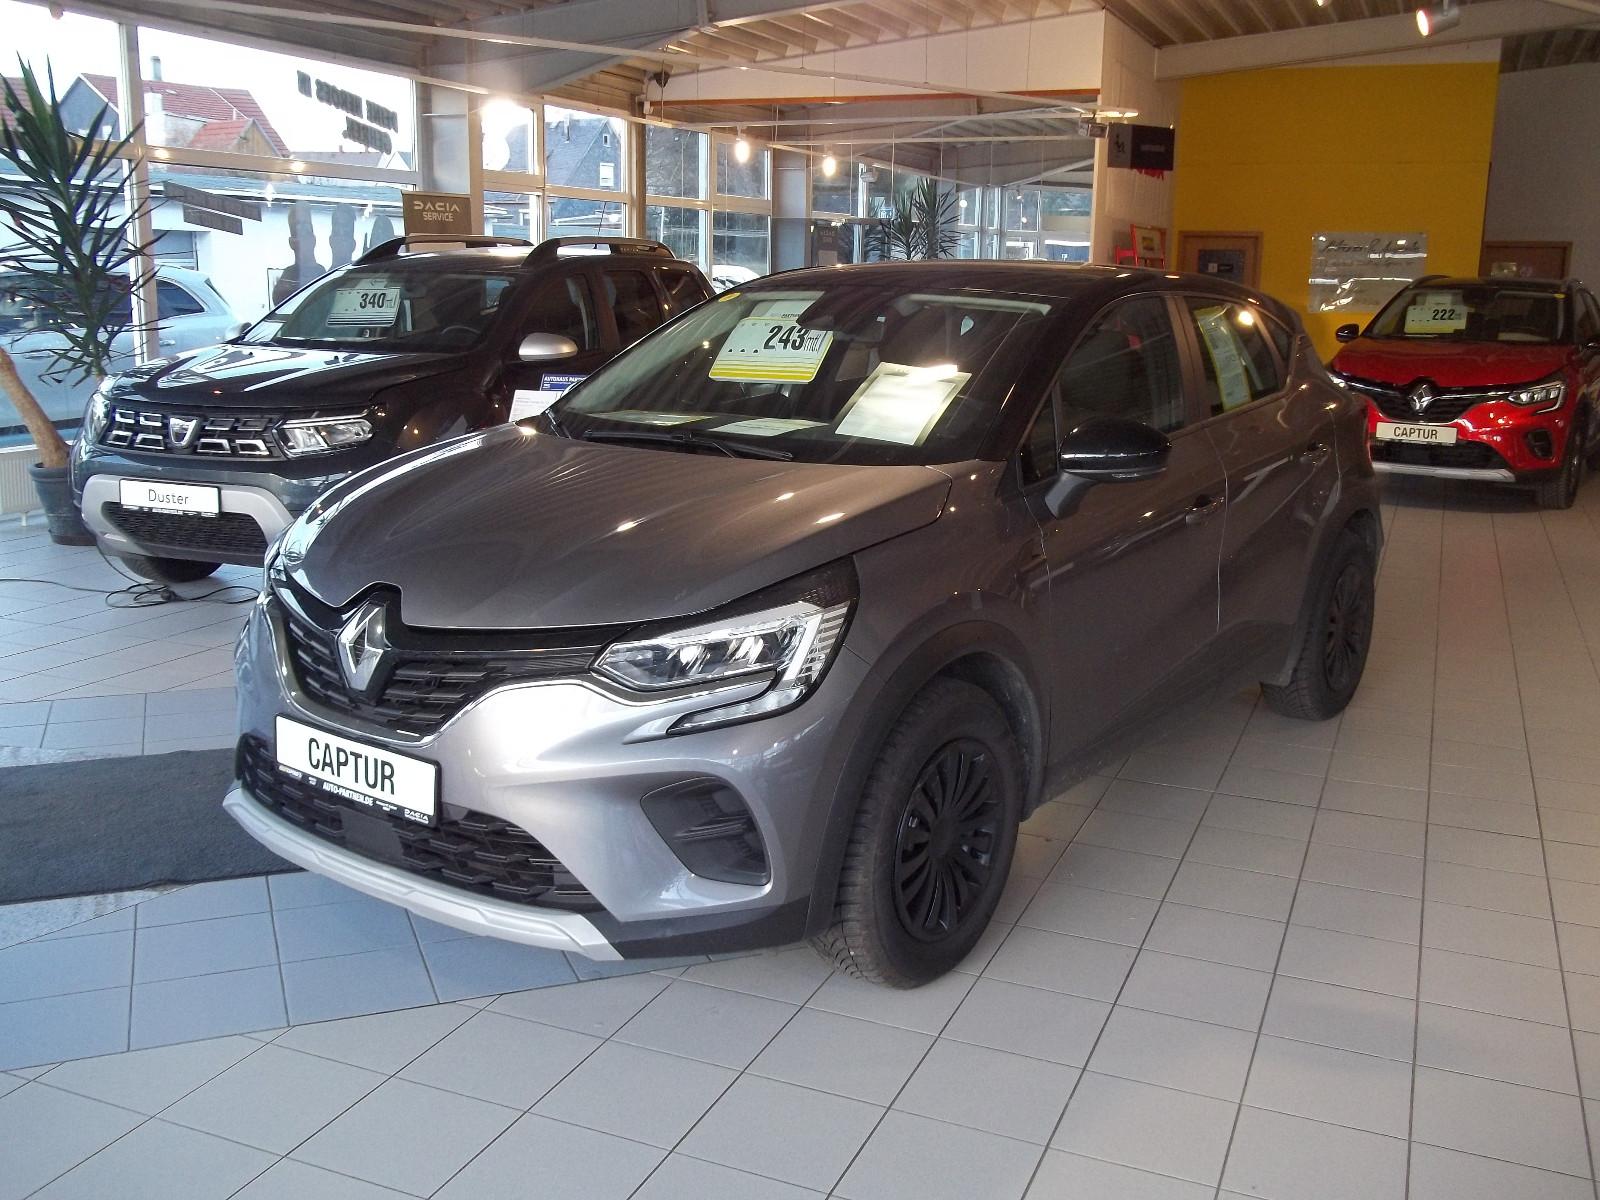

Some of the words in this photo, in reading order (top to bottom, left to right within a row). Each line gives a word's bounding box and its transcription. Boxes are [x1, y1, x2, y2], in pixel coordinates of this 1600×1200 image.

[413, 201, 460, 212] DACIA
[423, 212, 454, 222] SERVICE
[360, 293, 387, 310] 340
[1432, 309, 1456, 321] 222
[764, 325, 810, 351] 243
[1393, 426, 1438, 440] CAPTUR
[148, 489, 189, 505] Duster
[308, 737, 395, 795] CAPTUR
